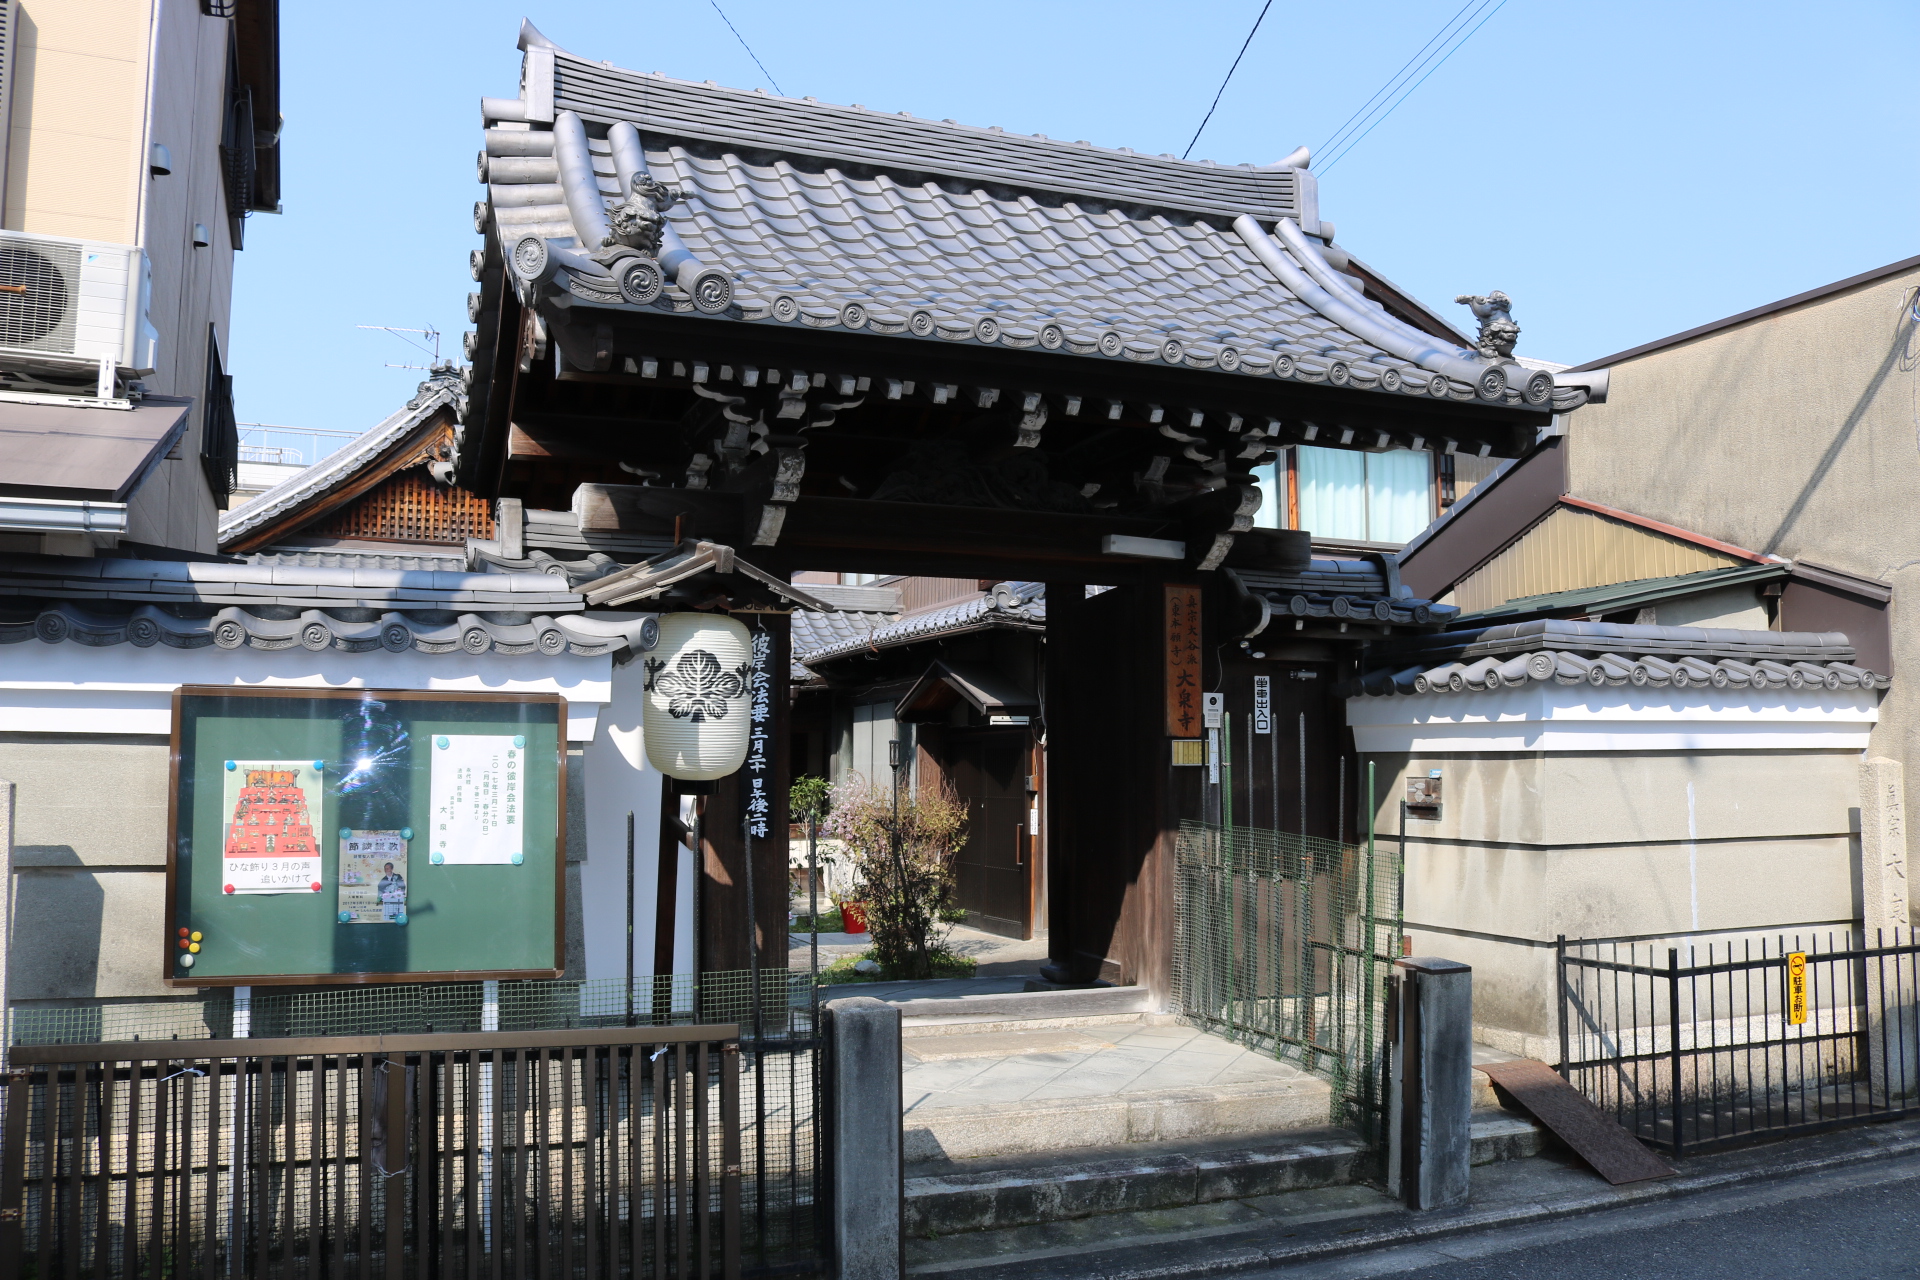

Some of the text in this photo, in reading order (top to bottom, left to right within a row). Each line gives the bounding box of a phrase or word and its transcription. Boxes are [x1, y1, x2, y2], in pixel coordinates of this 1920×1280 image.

[1186, 595, 1199, 664] 真宗大谷派
[1175, 669, 1196, 732] 大泉寺
[1256, 677, 1268, 730] 単車出入口
[491, 754, 499, 827] 二〇一七年三月二十日
[506, 749, 517, 825] 春の彼岸会法要
[229, 861, 311, 872] ひな飾り3月の声
[260, 873, 312, 884] 追いかけて
[1793, 976, 1803, 1021] 駐車お断り
